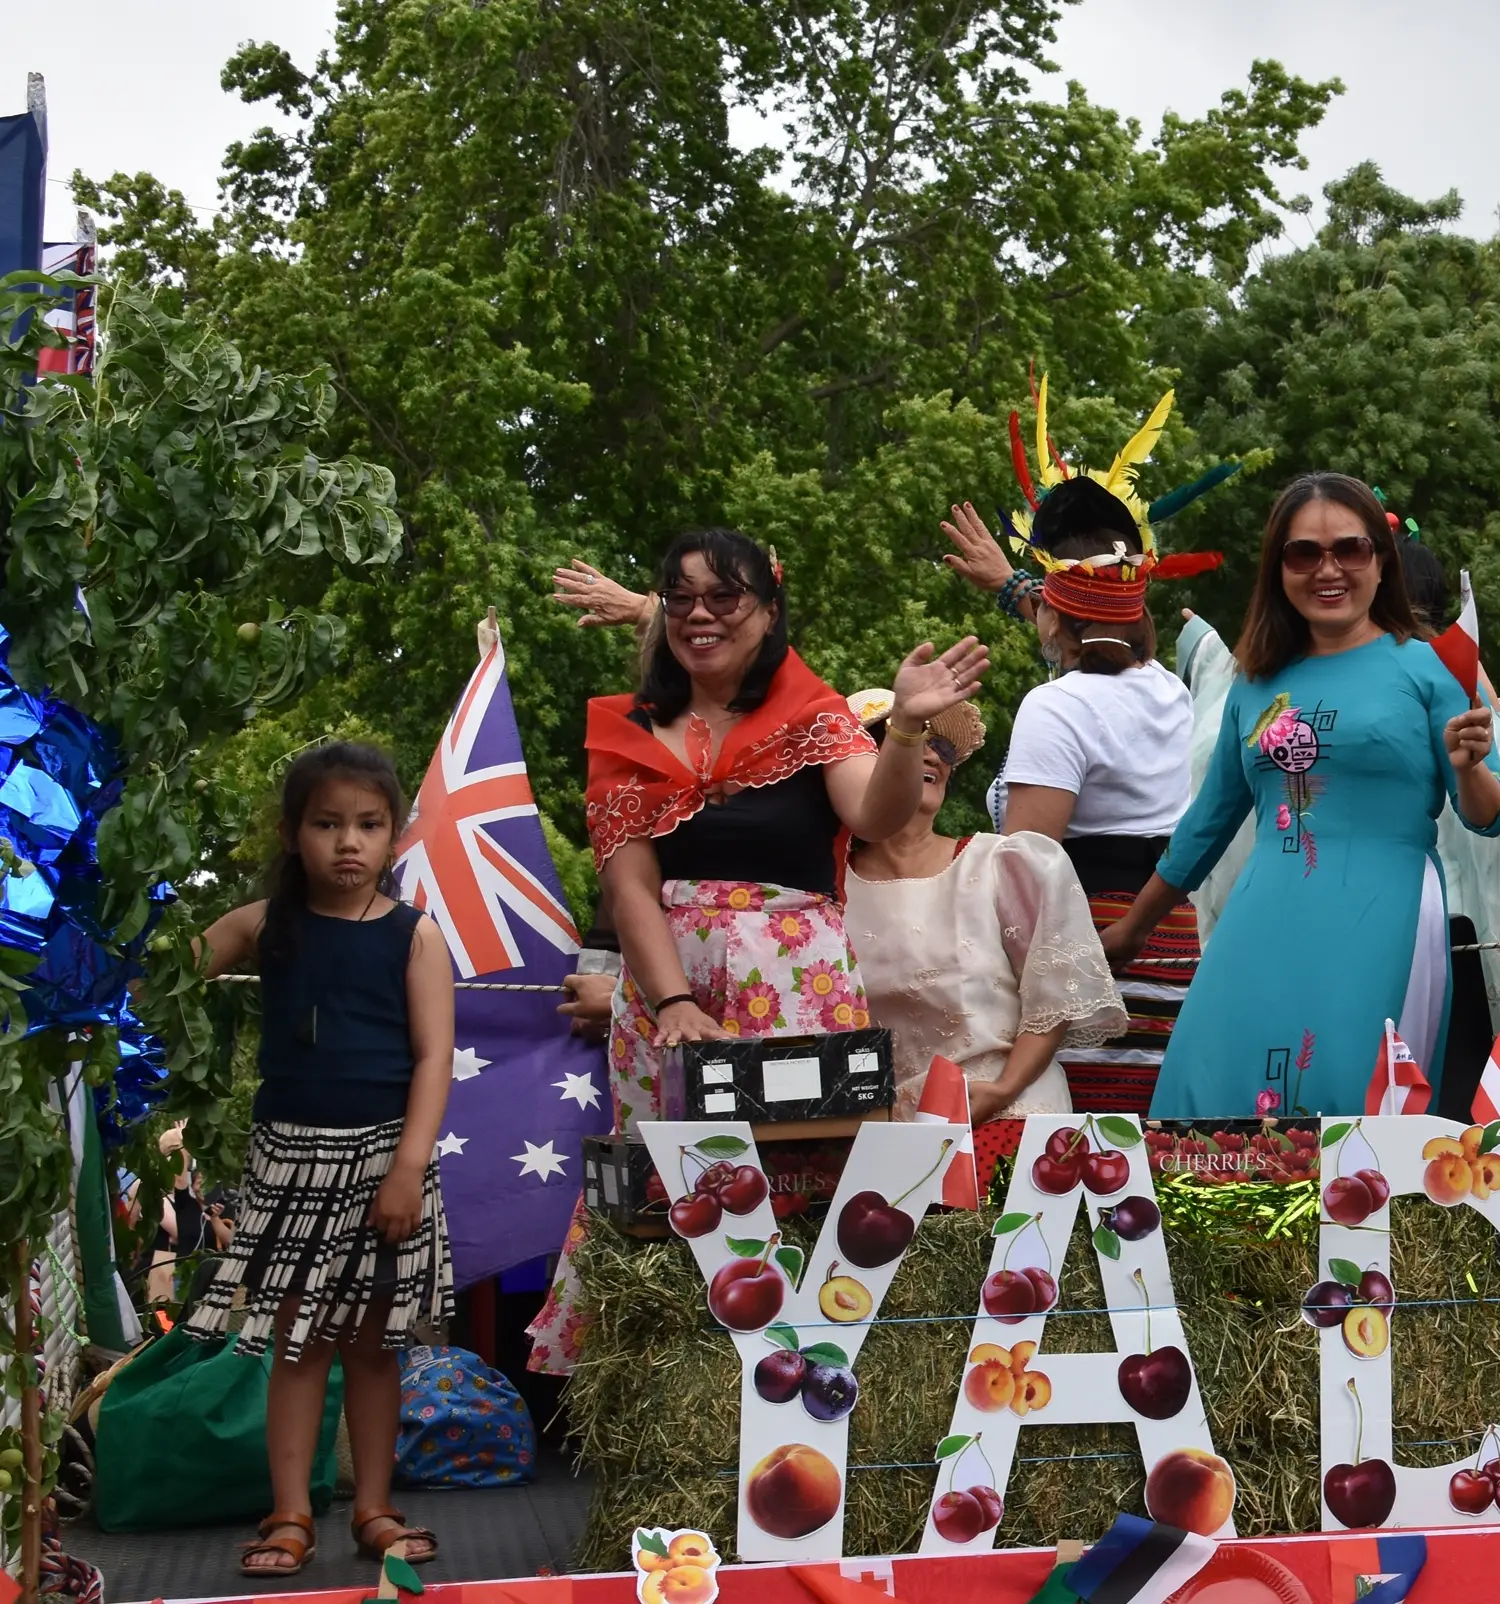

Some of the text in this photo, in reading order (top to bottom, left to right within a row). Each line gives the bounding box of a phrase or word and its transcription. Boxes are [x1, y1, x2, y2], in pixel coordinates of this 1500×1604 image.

[857, 1092, 875, 1101] 5KG
[1159, 1152, 1268, 1173] CHERRIES
[766, 1171, 826, 1193] RRIES
